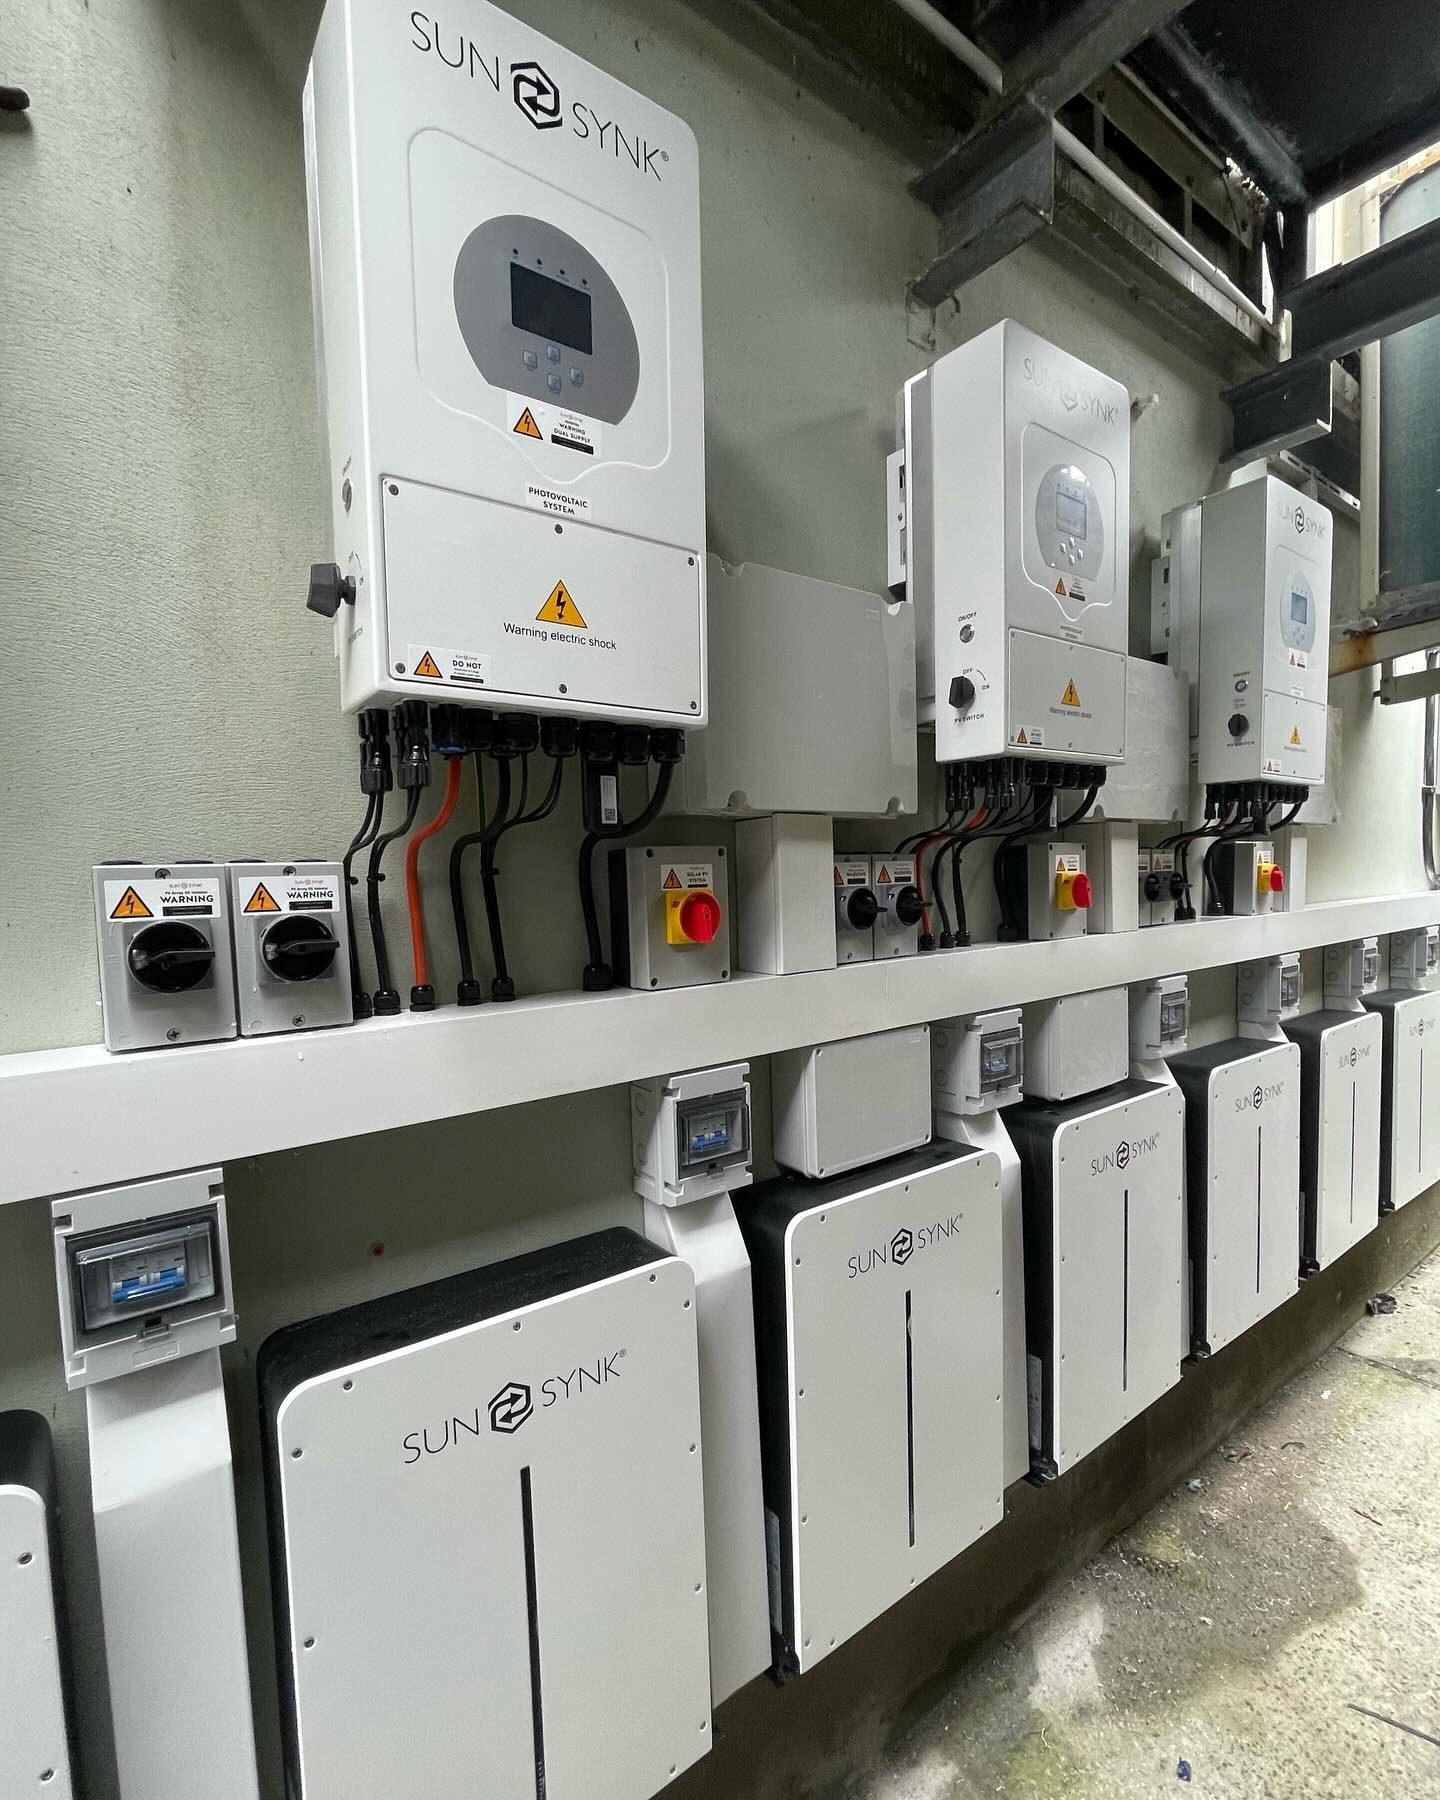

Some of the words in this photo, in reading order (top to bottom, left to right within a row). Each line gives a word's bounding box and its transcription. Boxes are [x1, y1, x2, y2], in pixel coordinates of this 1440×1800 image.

[410, 10, 501, 93] SUN
[553, 427, 569, 438] DUAL
[570, 433, 591, 444] SUPPLY
[559, 422, 586, 436] WARNING
[528, 486, 588, 509] PHOTOVOLTAIC
[543, 500, 575, 515] SYSTEM
[957, 611, 977, 623] ON/OFF
[503, 622, 548, 642] Warning
[550, 631, 586, 646] electric
[588, 636, 617, 650] shock
[452, 659, 464, 668] DO
[466, 662, 482, 670] NOT
[962, 667, 974, 675] OFF
[160, 895, 214, 904] WARNING
[286, 890, 334, 899] WARNING
[1235, 1094, 1252, 1113] SUN
[1090, 1151, 1114, 1176] SUN
[1131, 1134, 1158, 1159] SYNK
[848, 1244, 887, 1279] SUN
[403, 1408, 480, 1464] SUN
